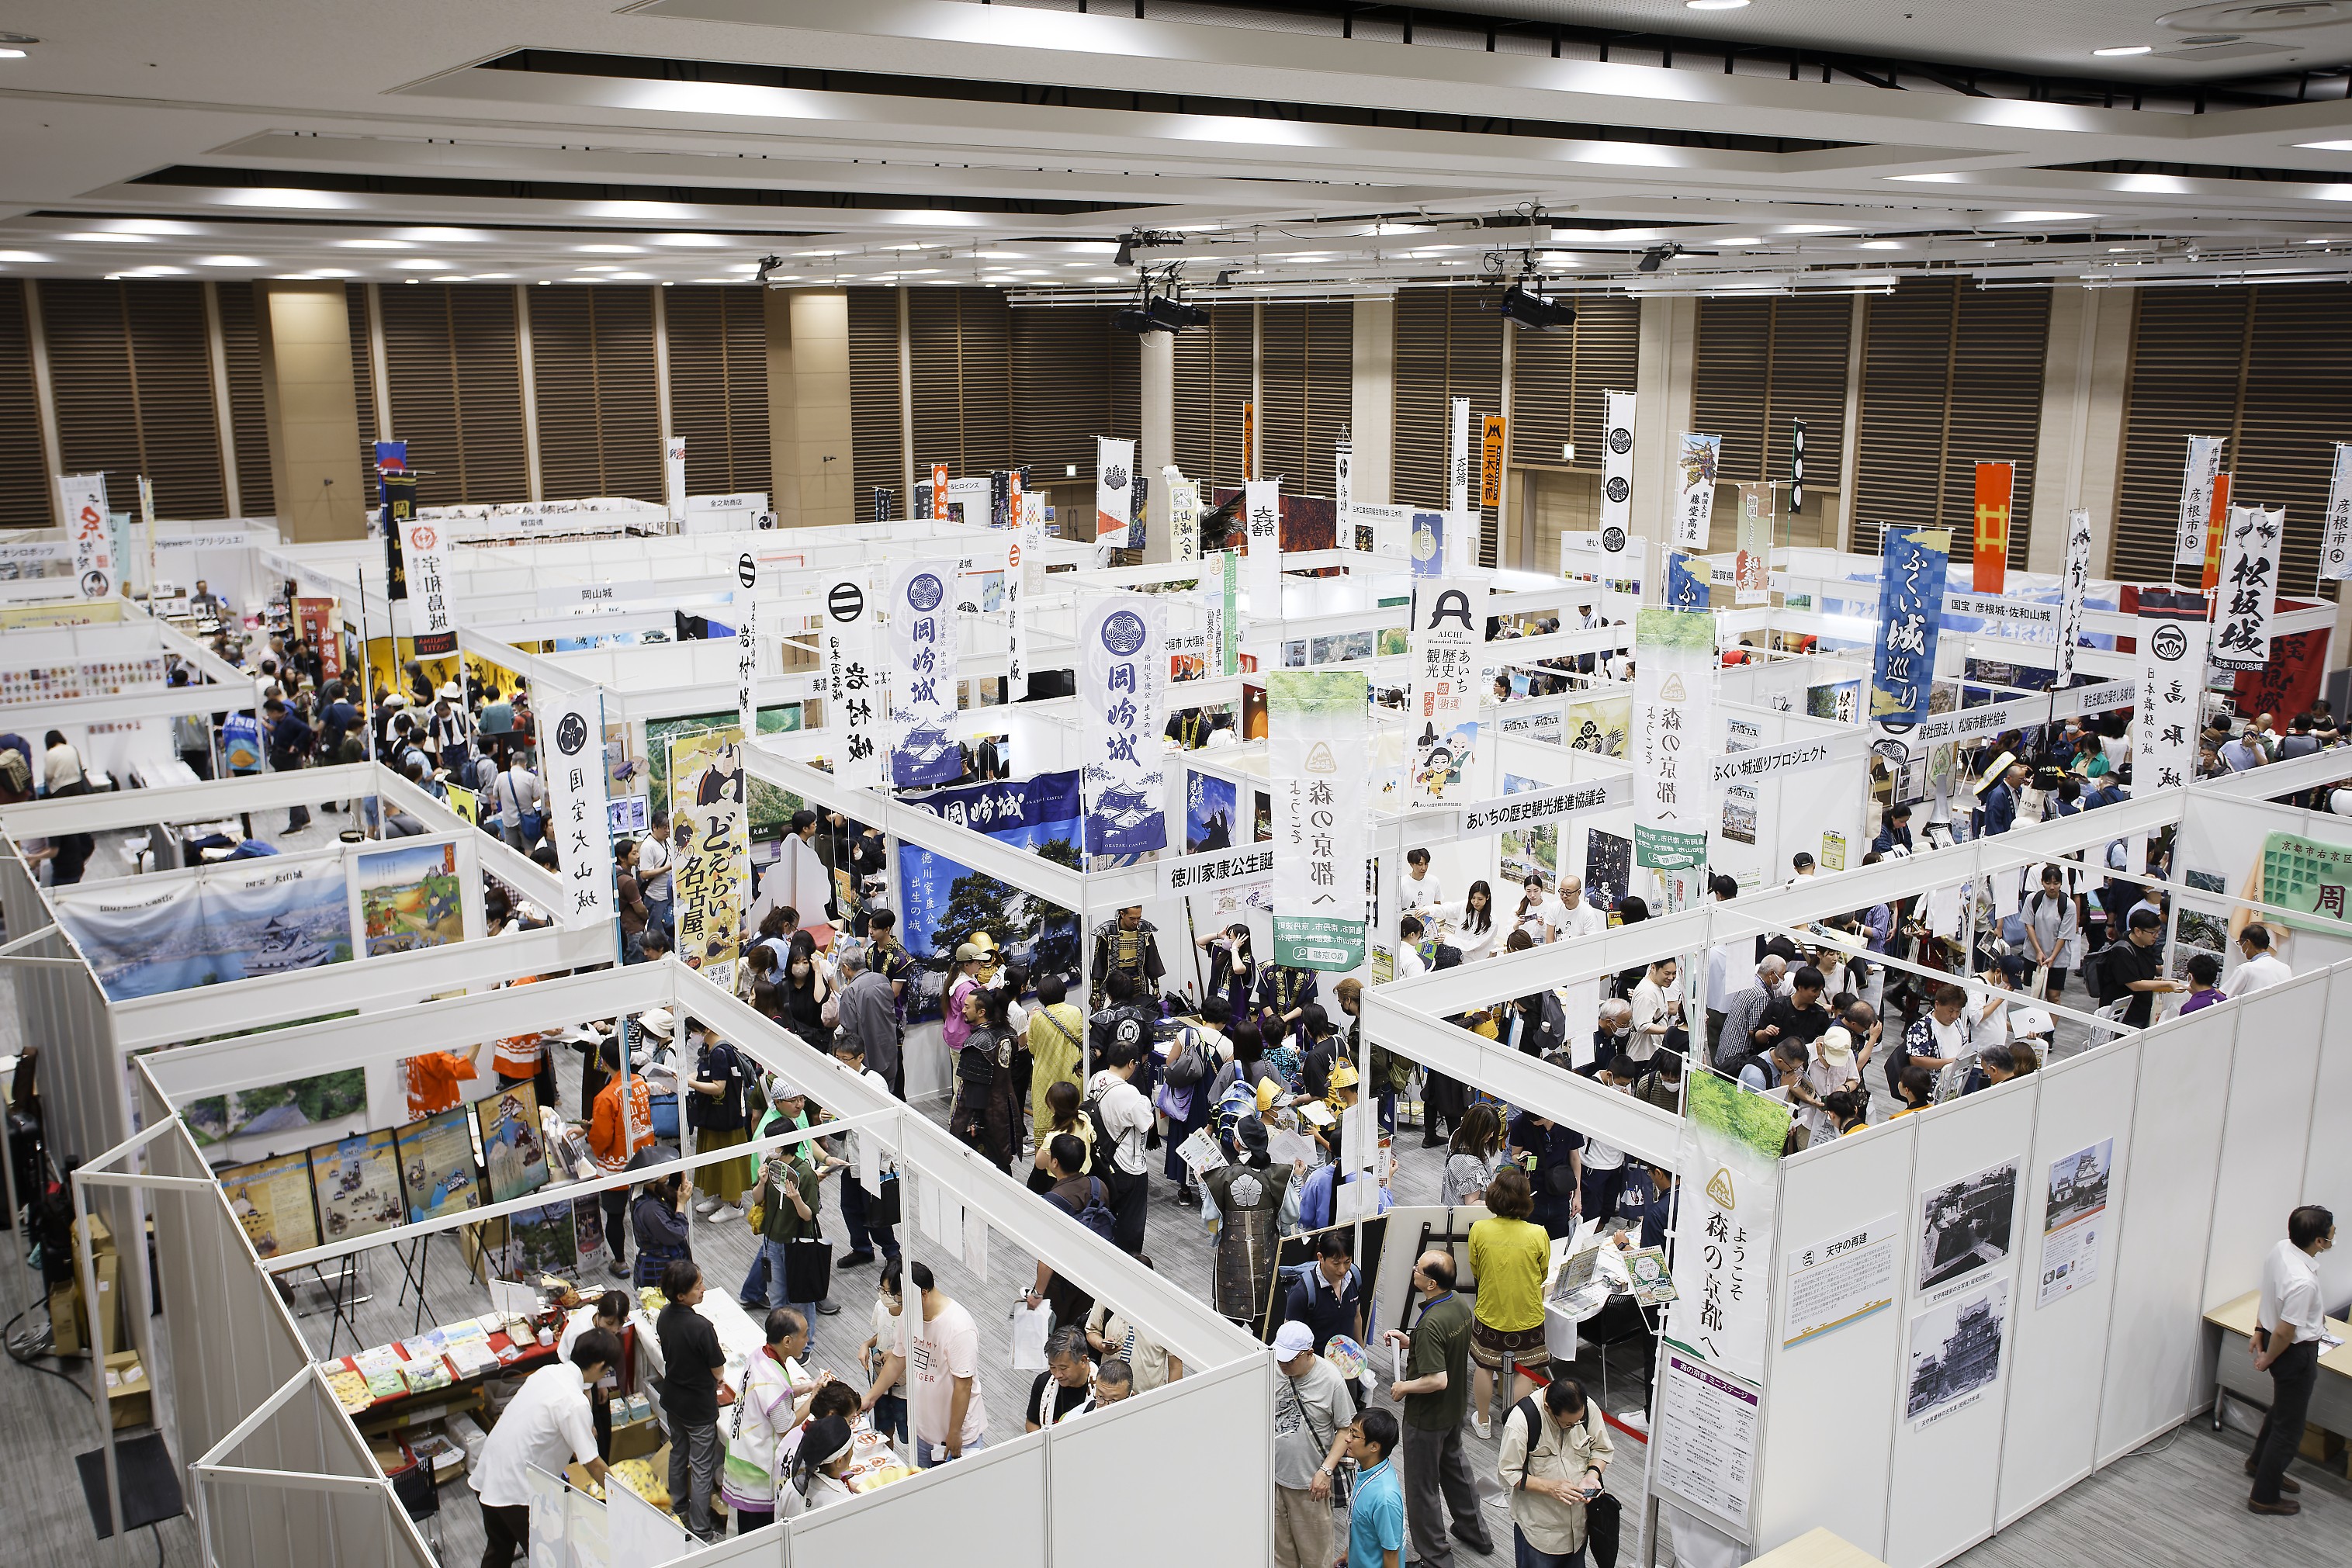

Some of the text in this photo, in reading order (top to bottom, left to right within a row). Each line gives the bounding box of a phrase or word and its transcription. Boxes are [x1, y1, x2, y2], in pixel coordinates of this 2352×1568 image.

[2206, 447, 2219, 486] 井伊直政
[710, 498, 743, 507] 金之助商店
[937, 492, 947, 520] 原城
[1686, 493, 1700, 540] 藤堂高虎
[1700, 492, 1709, 518] 戦国大名
[2186, 488, 2201, 533] 彦根市
[2332, 498, 2350, 546] 彦根市
[1711, 569, 1734, 581] 滋賀県
[582, 587, 613, 601] 岡山城
[1952, 599, 2051, 622] 国宝 彦根城・佐和山城
[1885, 549, 1928, 711] ふくい城巡り
[2286, 630, 2307, 662] 宝
[321, 627, 338, 673] 抽選会
[910, 617, 940, 706] 岡崎城
[940, 651, 948, 681] 出生の城
[1425, 649, 1440, 679] 観光
[1441, 649, 1457, 679] 歴史
[2215, 659, 2264, 672] 日本100名城
[740, 624, 750, 713] 岩村城
[1457, 649, 1470, 693] あいち
[1424, 692, 1435, 716] 武将
[1438, 683, 1449, 694] 城
[1439, 697, 1460, 709] 街道
[1107, 662, 1141, 767] 岡崎城
[1143, 704, 1152, 739] 出生の城
[1730, 724, 1758, 737] お城フェス
[1959, 710, 2007, 733] 松阪市観光協会
[1713, 745, 1827, 781] ふくい城巡りプロジェクト
[944, 790, 1025, 829] 岡崎城
[1467, 787, 1606, 830] あいちの歴史観光推進協議会
[1727, 786, 1755, 800] お城フェス
[702, 812, 736, 916] どえらい
[2281, 841, 2352, 864] 京都市右京区
[273, 870, 303, 885] 犬山城
[1171, 852, 1273, 889] 徳川家康公生誕
[676, 857, 705, 941] 名古屋。
[908, 877, 922, 932] 出生の城
[921, 852, 935, 925] 徳川家康公
[2312, 884, 2346, 919] 周
[1826, 1232, 1867, 1258] 天守の再建
[1730, 1227, 1748, 1301] ようこそ
[1700, 1211, 1729, 1358] 森の京都へ
[1679, 1362, 1748, 1399] 森の京都 ミニステージ
